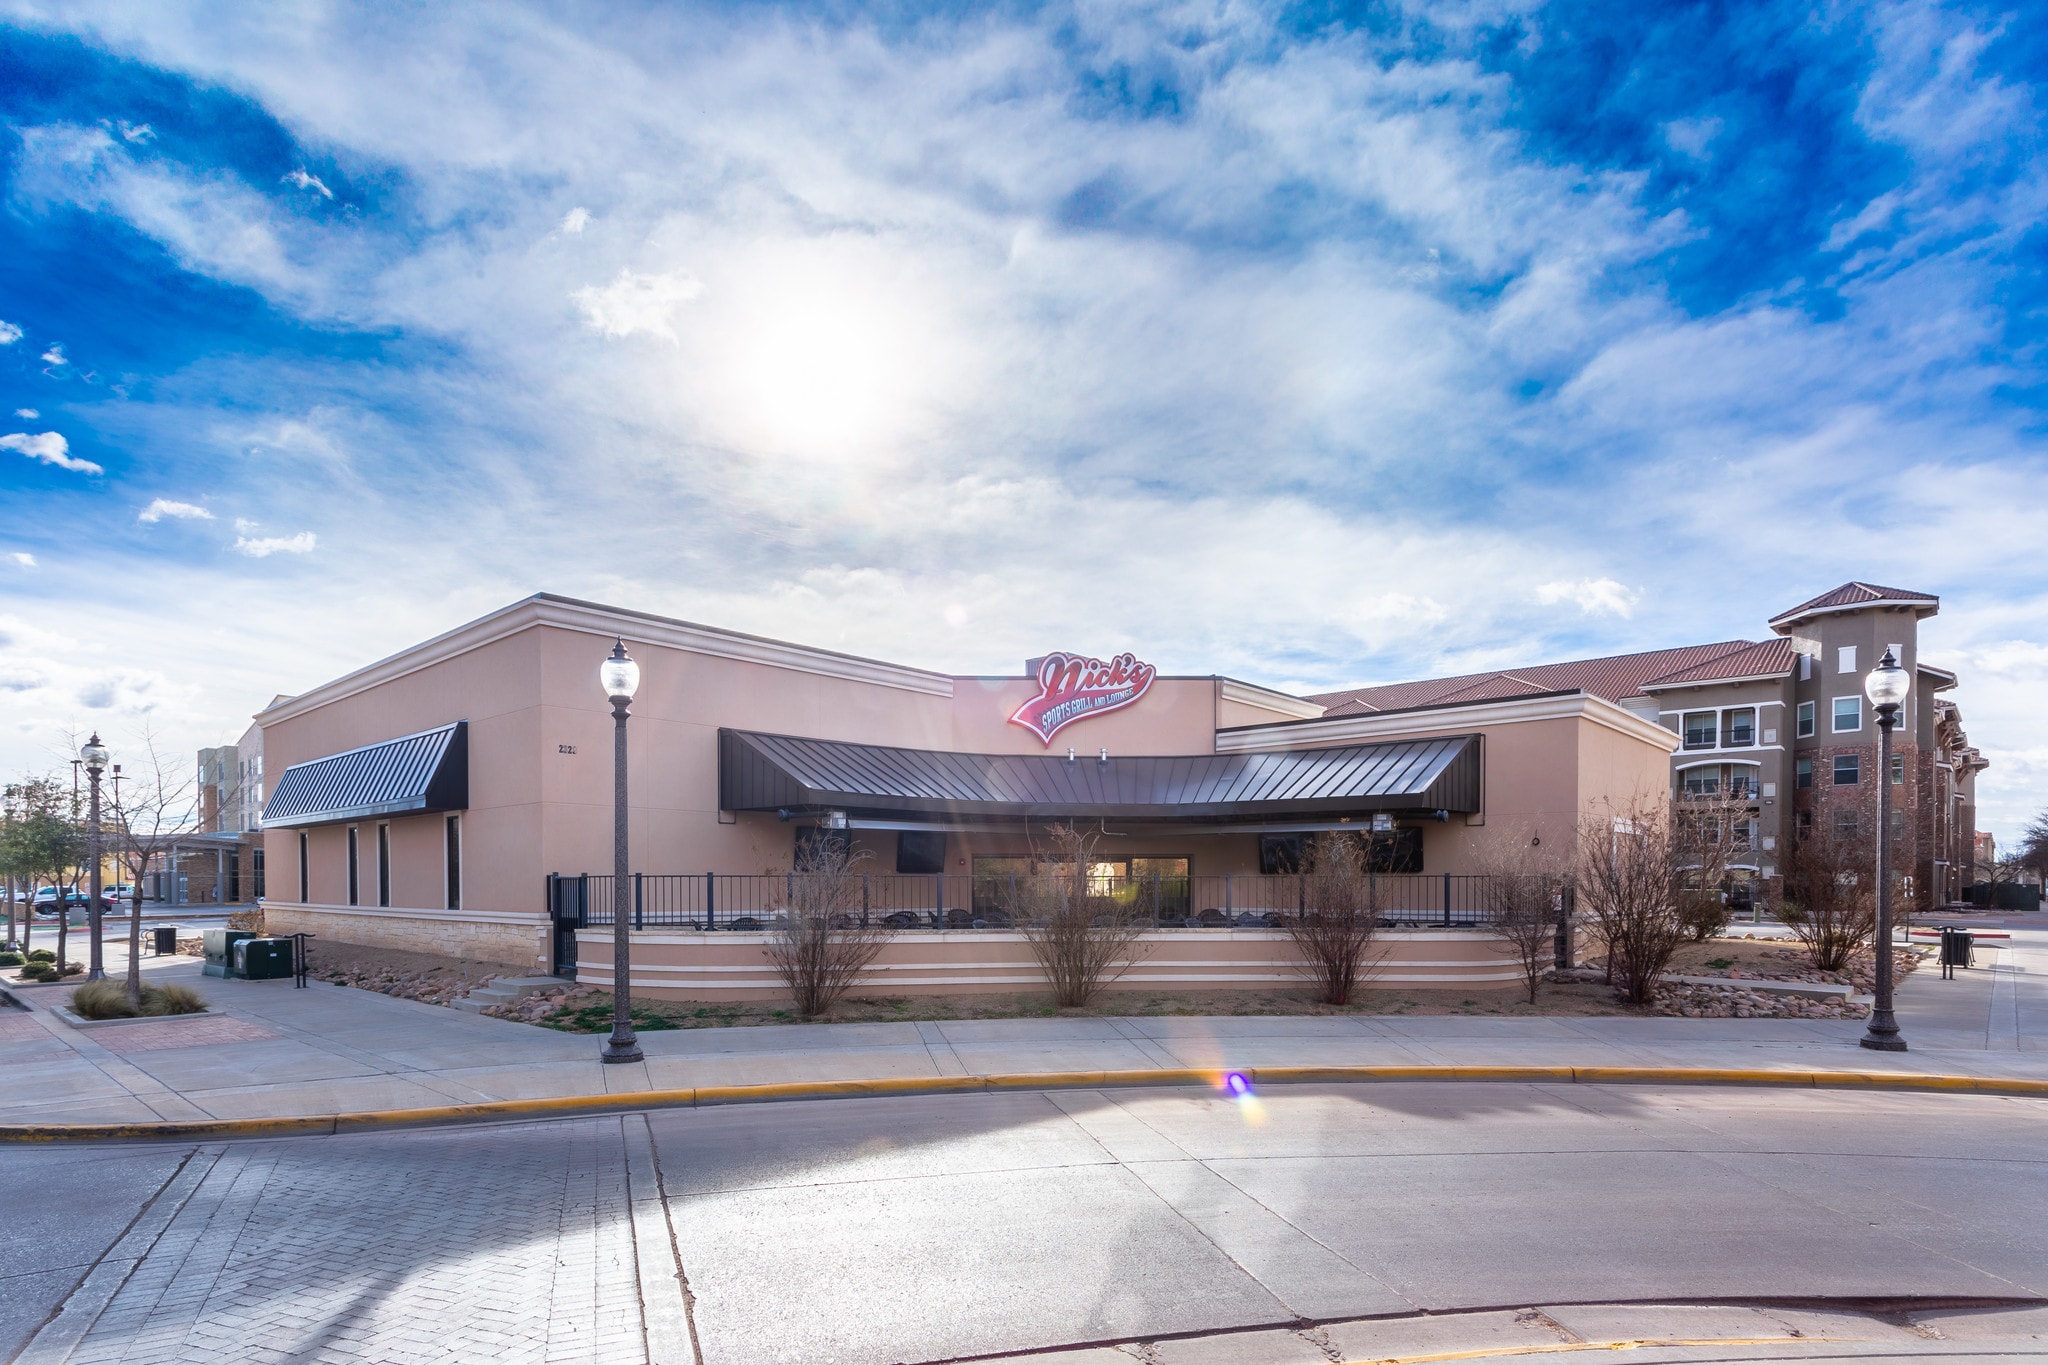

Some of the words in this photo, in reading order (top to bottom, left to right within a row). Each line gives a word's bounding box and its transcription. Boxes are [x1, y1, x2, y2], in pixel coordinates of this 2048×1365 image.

[1042, 655, 1145, 699] Nick's
[1042, 703, 1071, 733] SPORTS
[1071, 697, 1092, 714] GRILL
[1094, 697, 1105, 706] AND
[1107, 688, 1134, 705] LOUNGE
